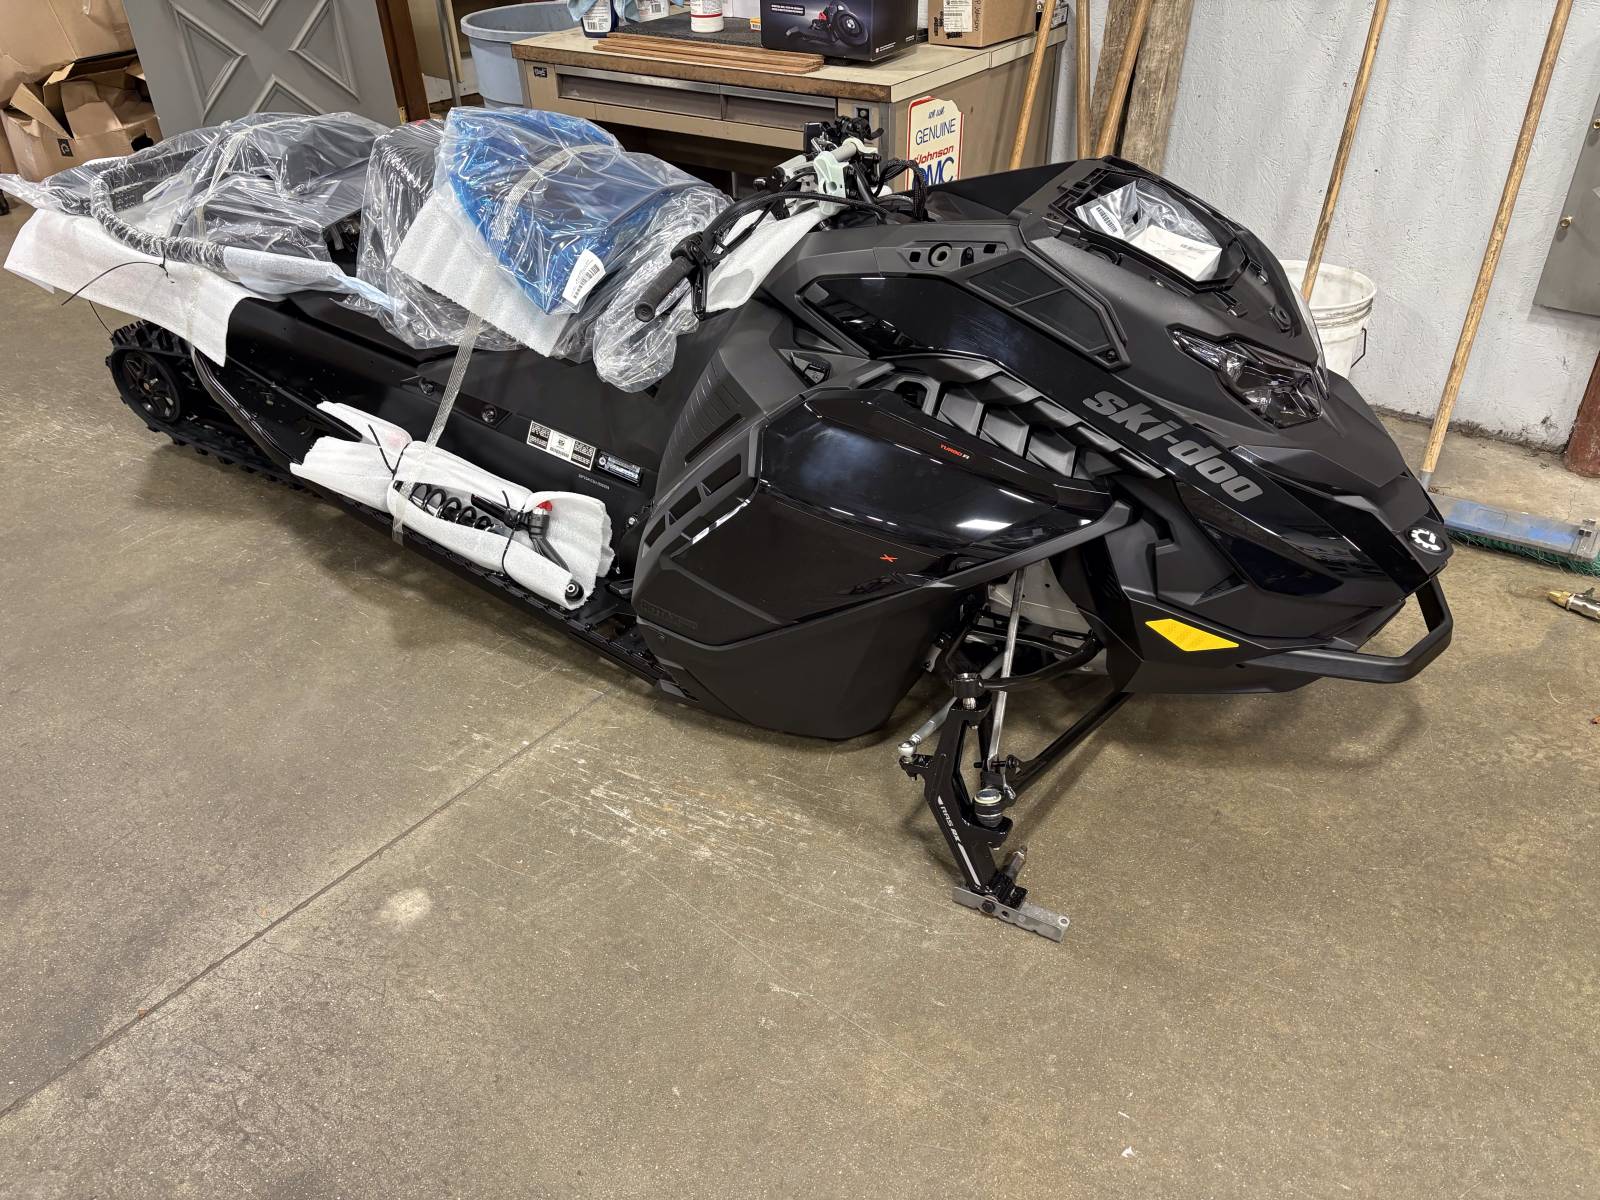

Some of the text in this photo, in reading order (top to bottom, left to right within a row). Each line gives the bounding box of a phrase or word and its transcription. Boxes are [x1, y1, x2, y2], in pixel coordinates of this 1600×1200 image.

[915, 118, 956, 145] GENUINE
[914, 145, 954, 164] Johnson
[1083, 390, 1263, 502] ski-doo
